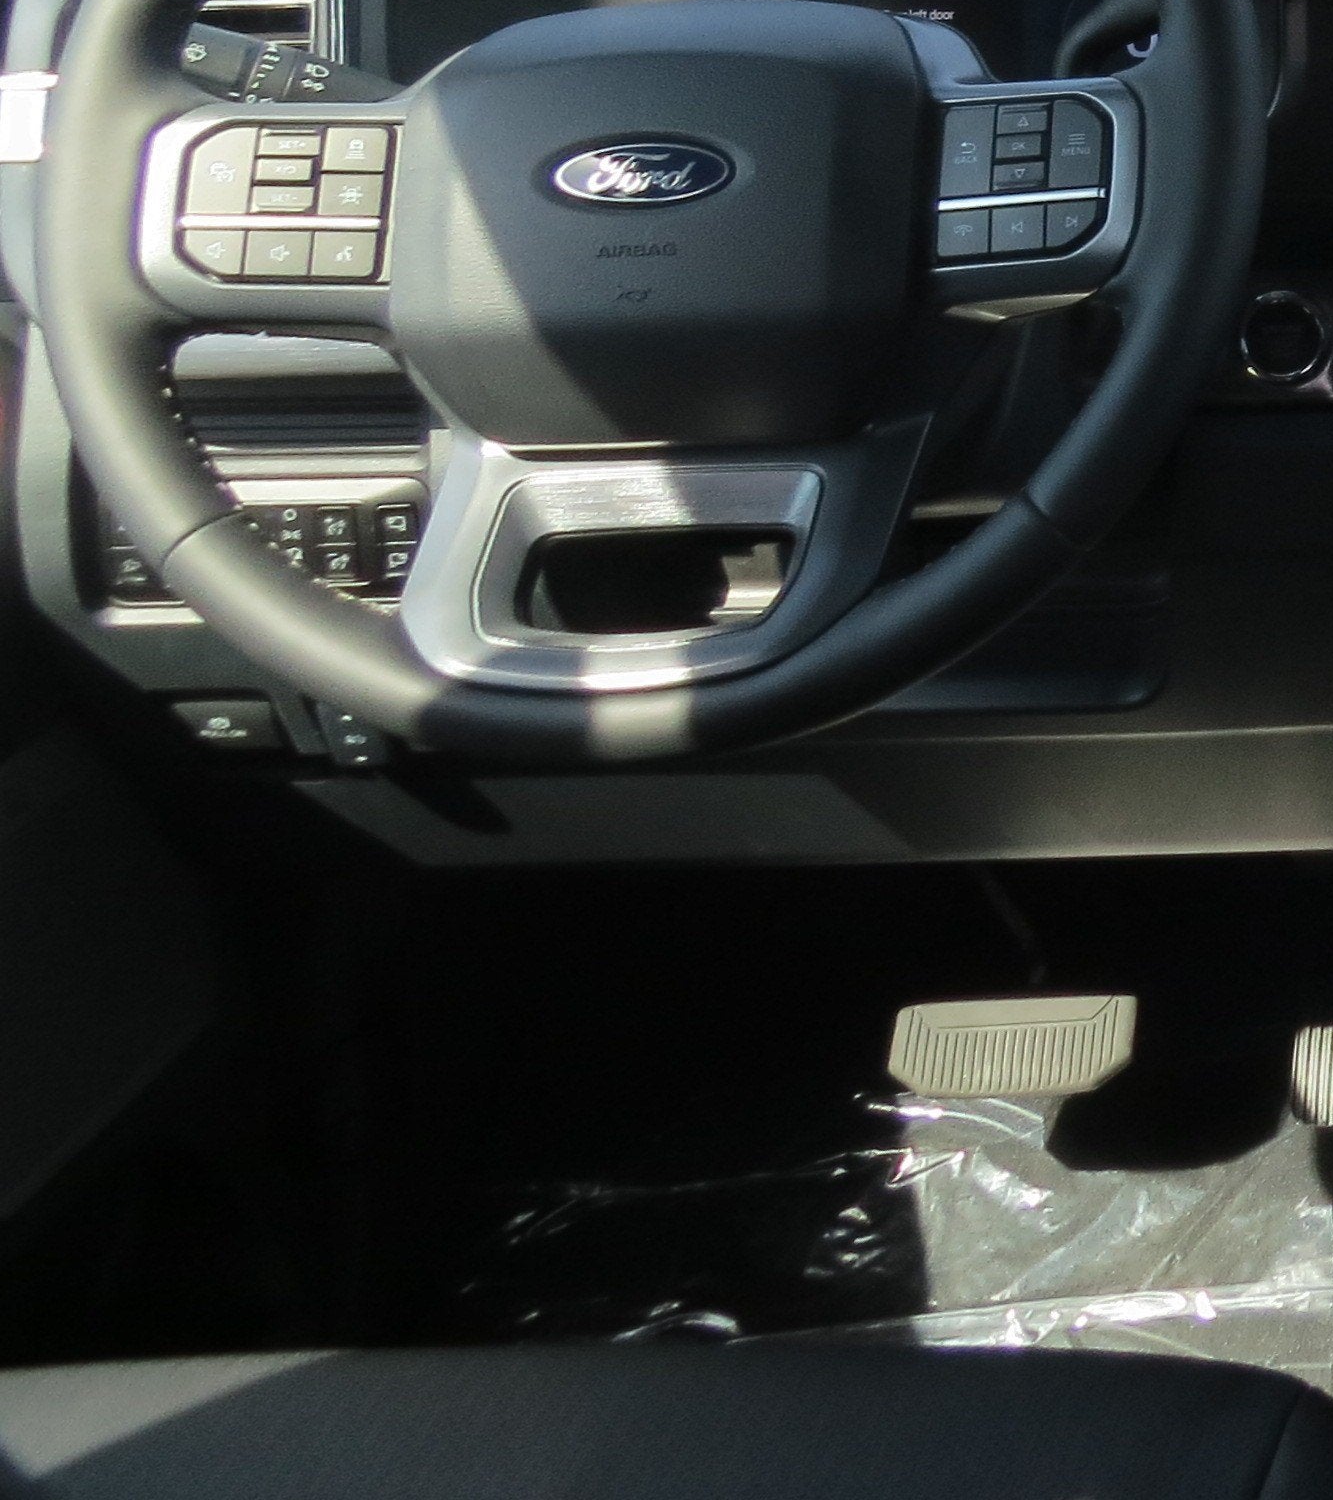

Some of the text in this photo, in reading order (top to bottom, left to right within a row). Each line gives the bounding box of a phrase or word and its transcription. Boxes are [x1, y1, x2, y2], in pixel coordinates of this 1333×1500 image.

[929, 9, 955, 20] door
[1060, 146, 1091, 156] MENU
[587, 152, 697, 194] Ford
[597, 241, 678, 258] AIRBAG
